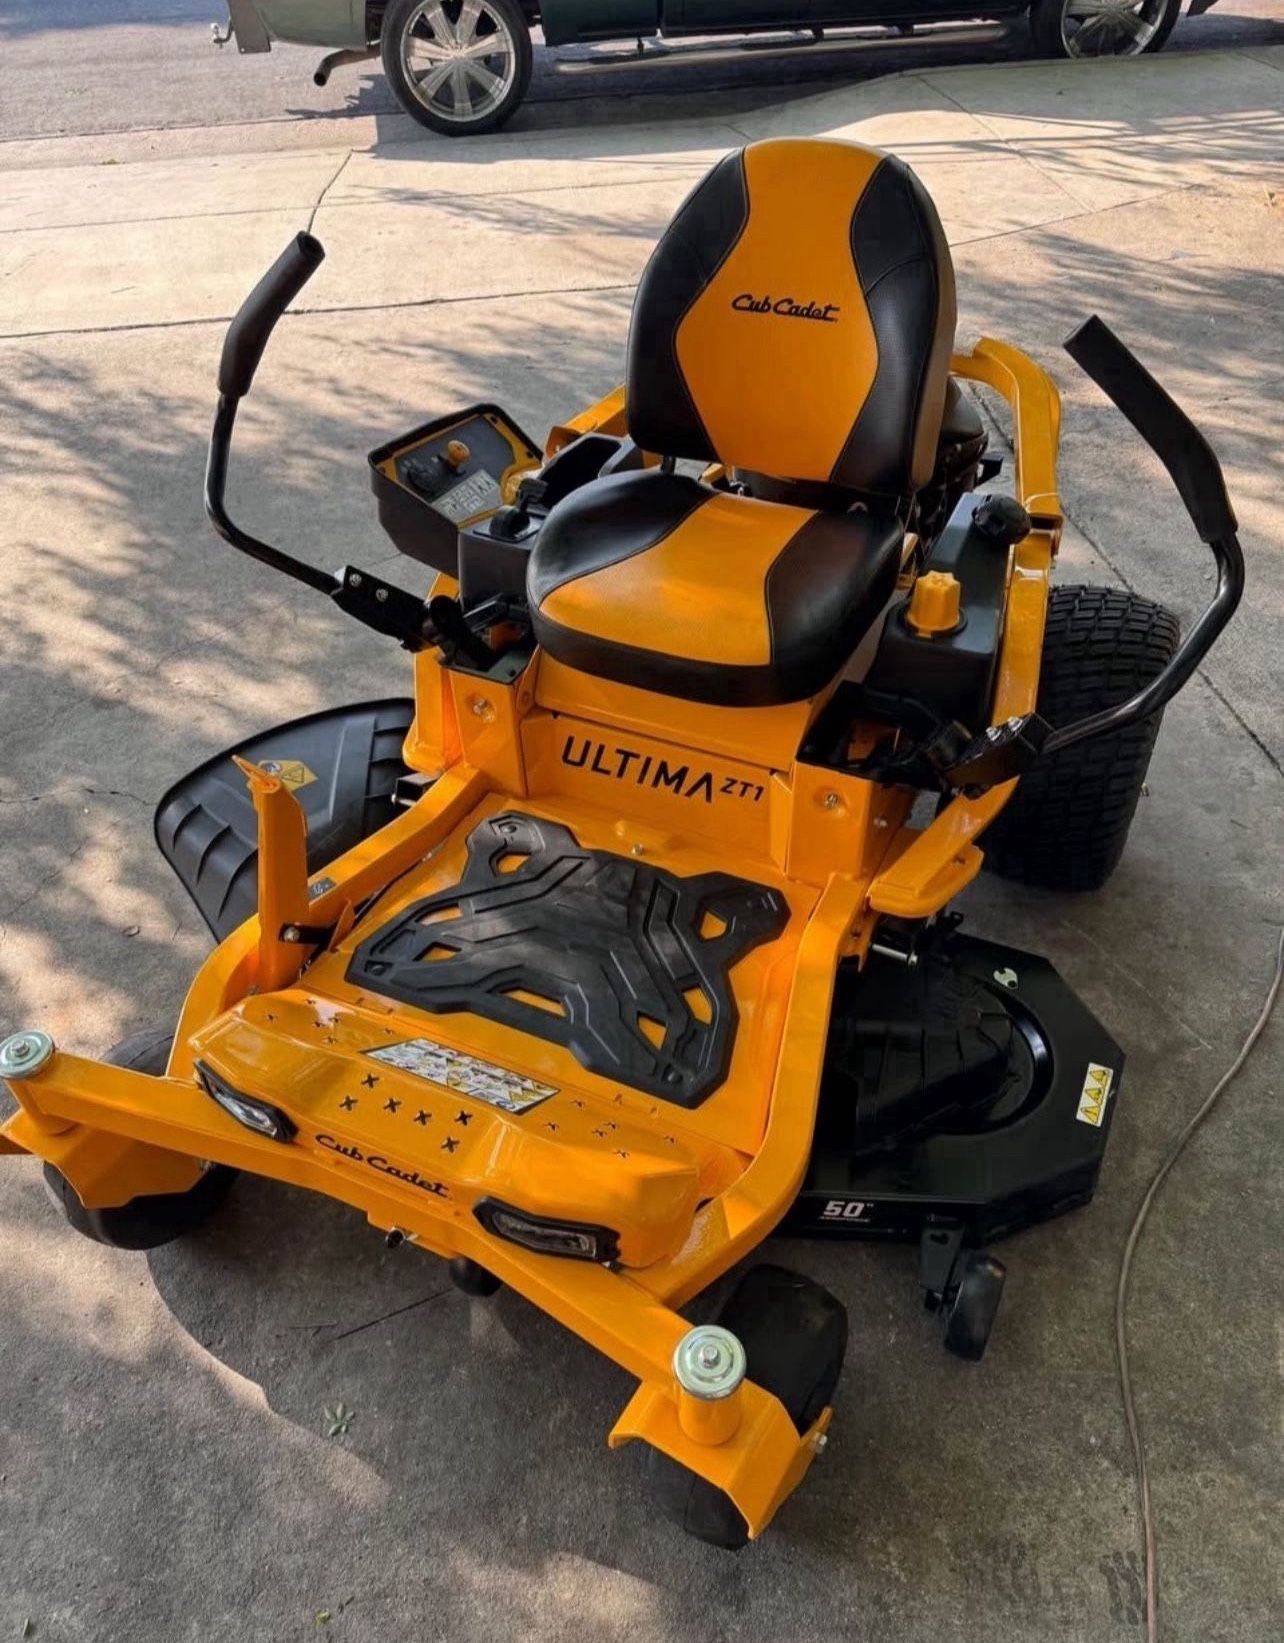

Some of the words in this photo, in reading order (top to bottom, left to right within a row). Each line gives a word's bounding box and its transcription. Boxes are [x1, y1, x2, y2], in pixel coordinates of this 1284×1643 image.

[732, 294, 771, 313] Cub
[773, 298, 840, 322] Cadet
[561, 735, 713, 803] ULTIMA
[719, 777, 764, 801] ZT1
[315, 1134, 364, 1161] Cub
[366, 1156, 449, 1198] Cadet
